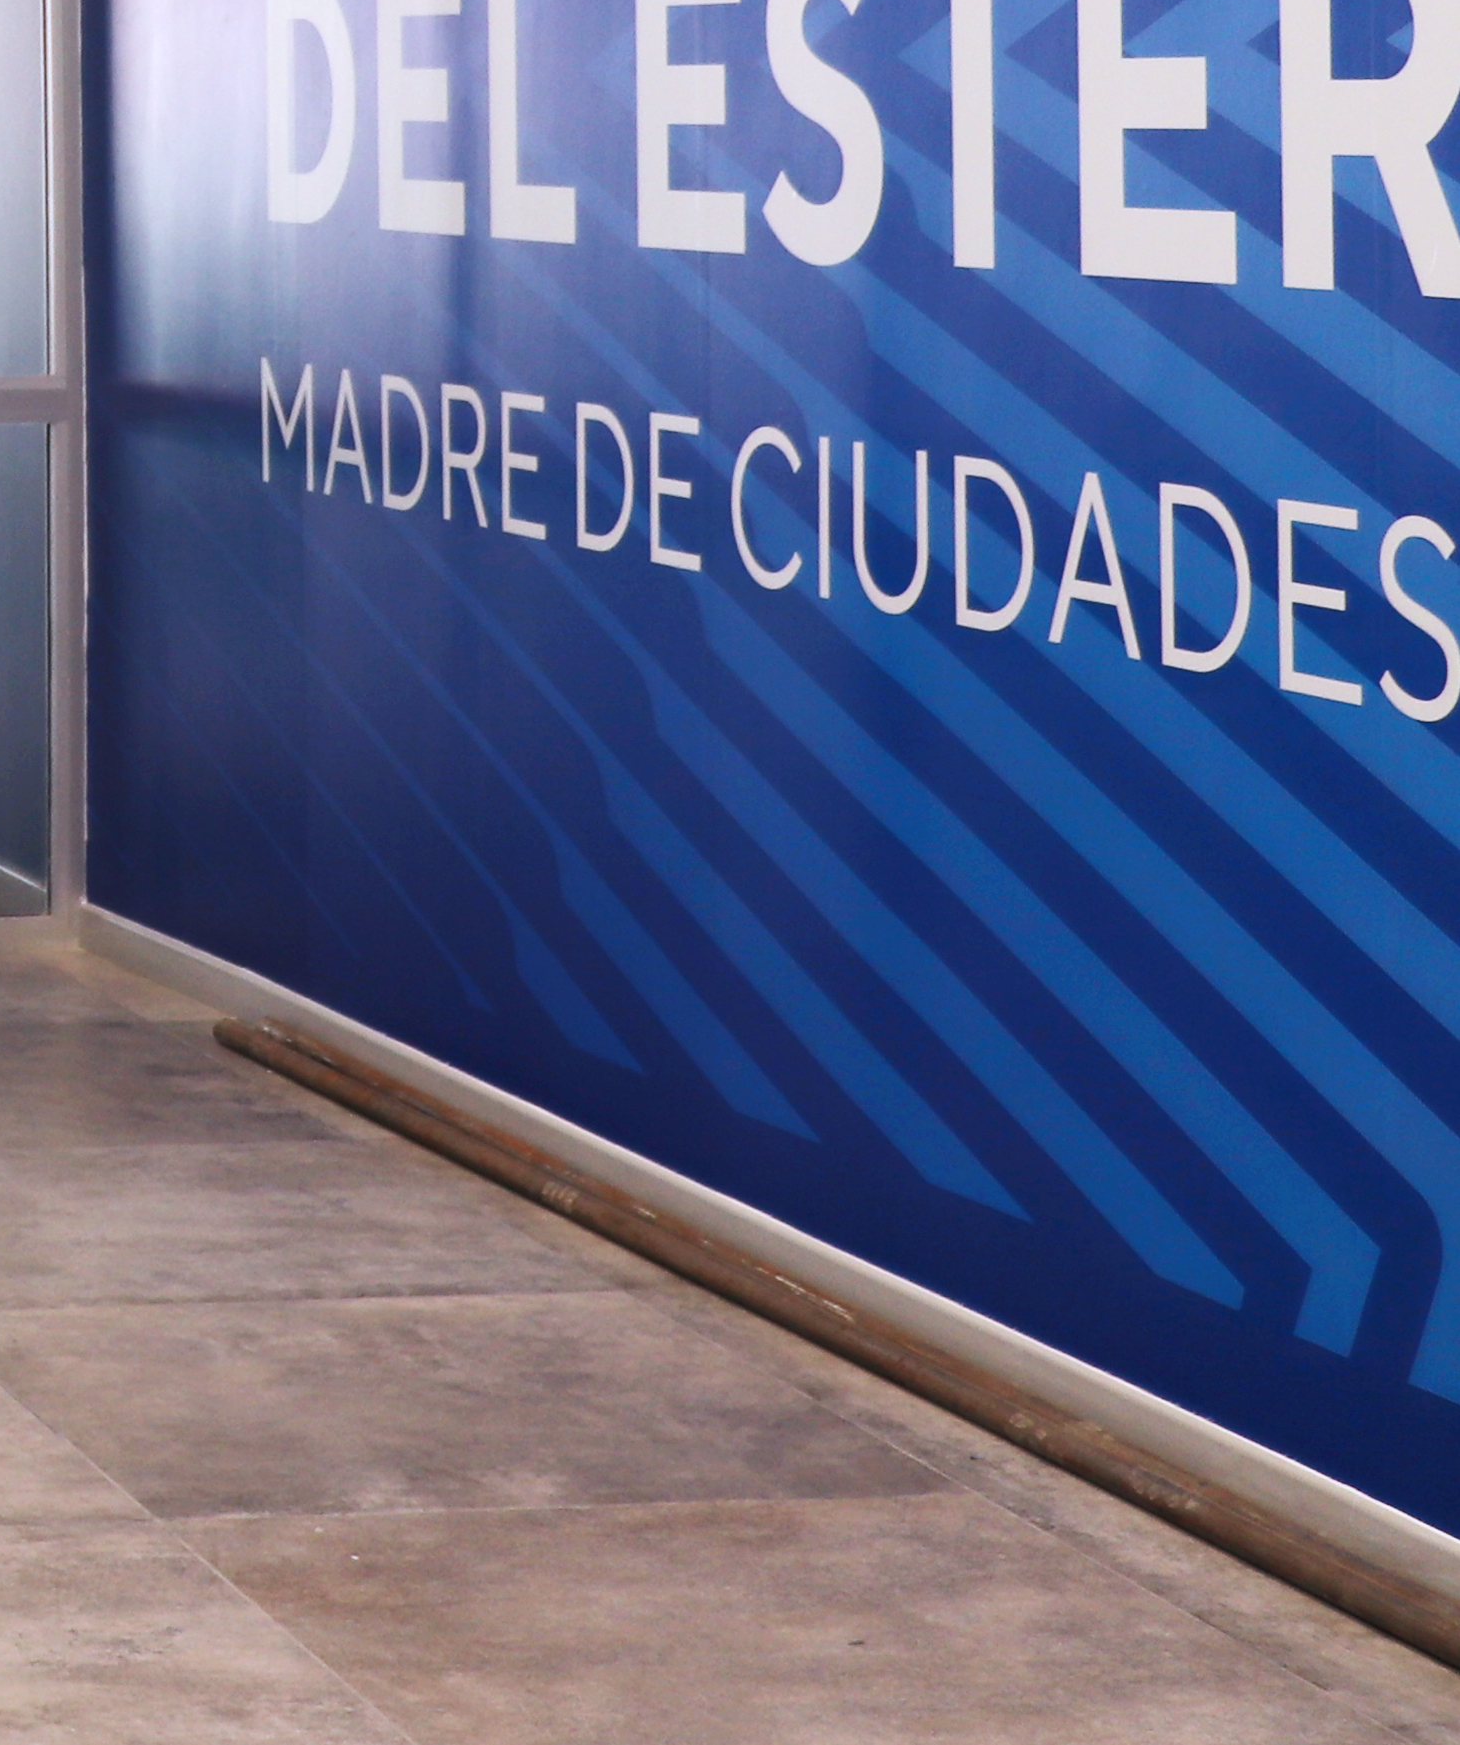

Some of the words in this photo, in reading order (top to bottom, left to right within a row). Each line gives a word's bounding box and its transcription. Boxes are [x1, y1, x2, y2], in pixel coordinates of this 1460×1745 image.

[259, 356, 546, 541] MADRE
[574, 401, 702, 572] DE
[730, 425, 1460, 723] CIUDADES
